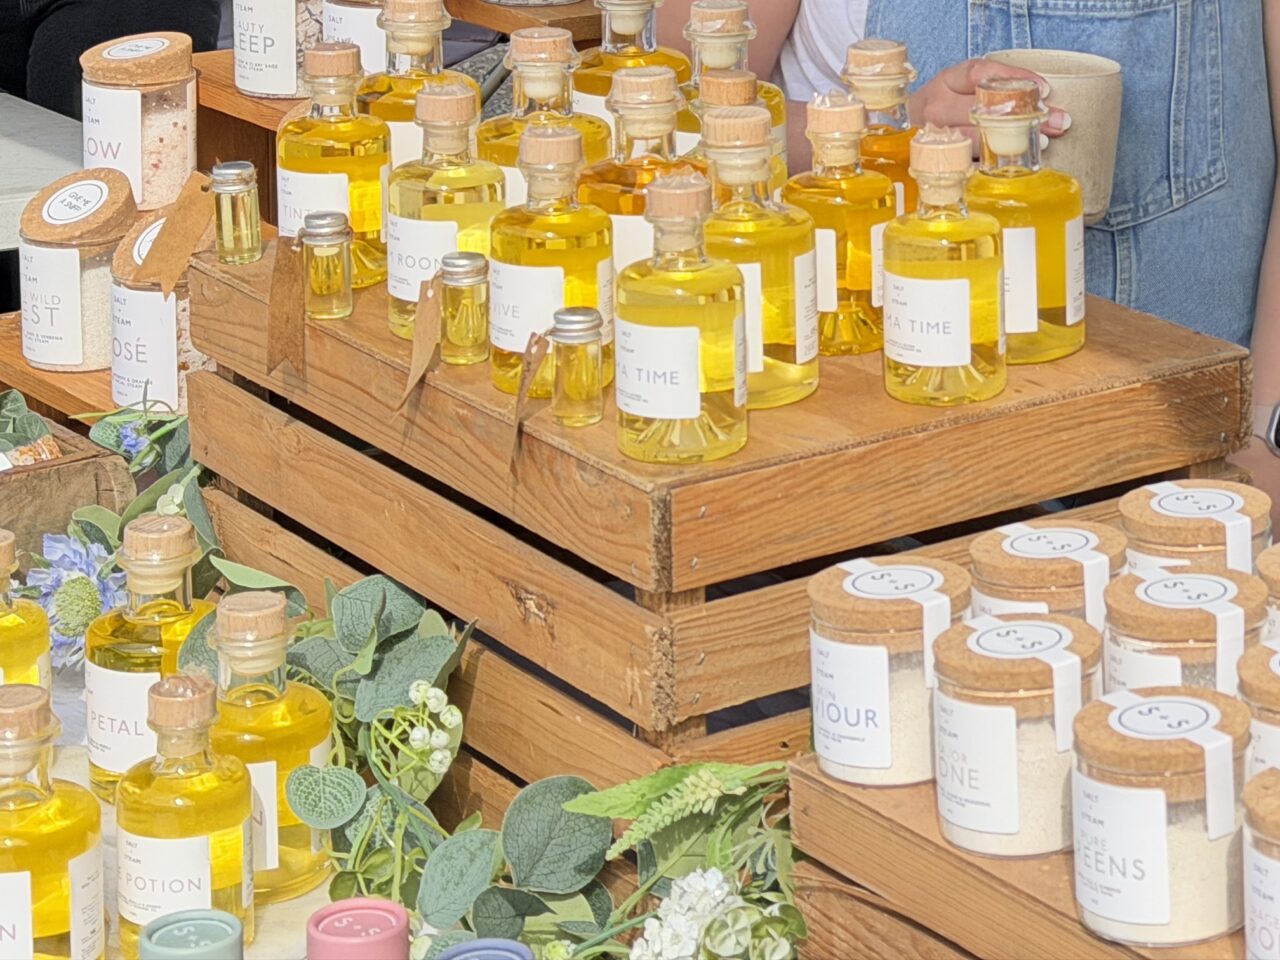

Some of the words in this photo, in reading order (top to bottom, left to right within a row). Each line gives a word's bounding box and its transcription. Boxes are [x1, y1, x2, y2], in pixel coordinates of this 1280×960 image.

[30, 292, 61, 305] WILD
[909, 319, 952, 335] TIME
[635, 368, 680, 385] TIME
[91, 710, 144, 736] PETAL
[1077, 842, 1146, 881] EENS
[126, 872, 202, 893] POTION
